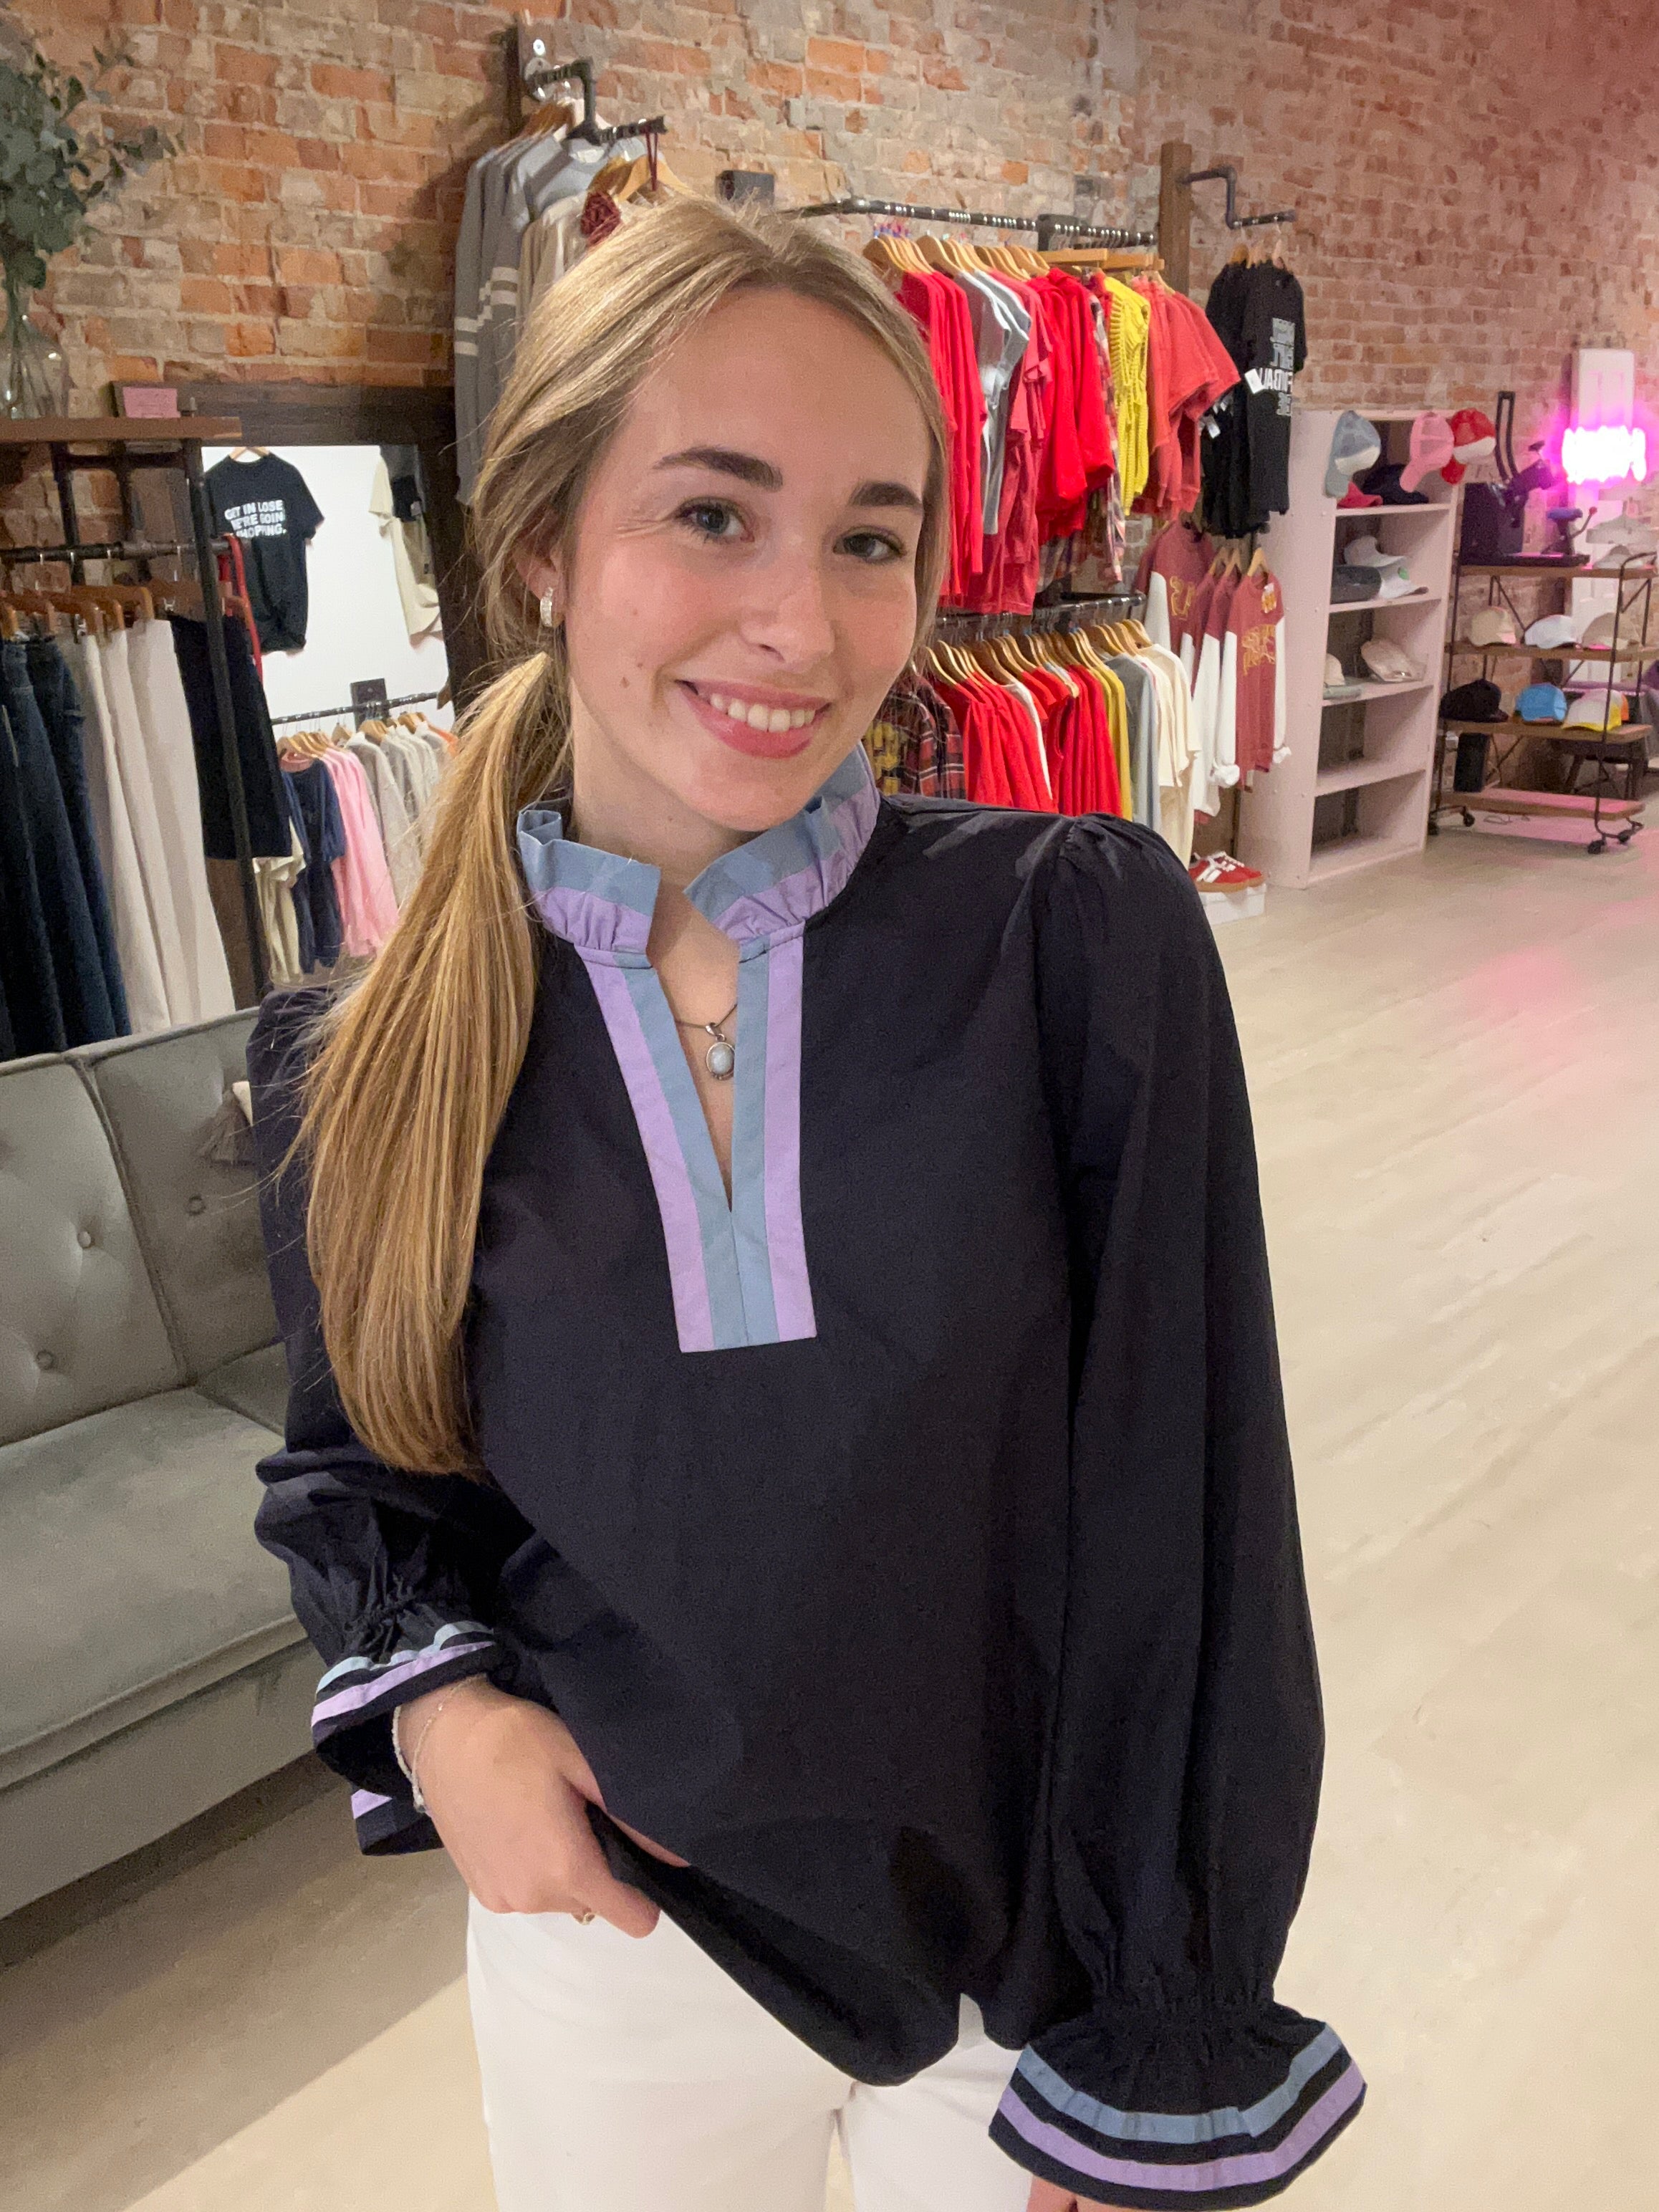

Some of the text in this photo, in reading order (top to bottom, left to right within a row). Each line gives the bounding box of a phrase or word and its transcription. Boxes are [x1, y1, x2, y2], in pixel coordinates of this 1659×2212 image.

[242, 502, 256, 515] IN
[257, 499, 284, 513] LOSE
[259, 511, 285, 524] GOIN
